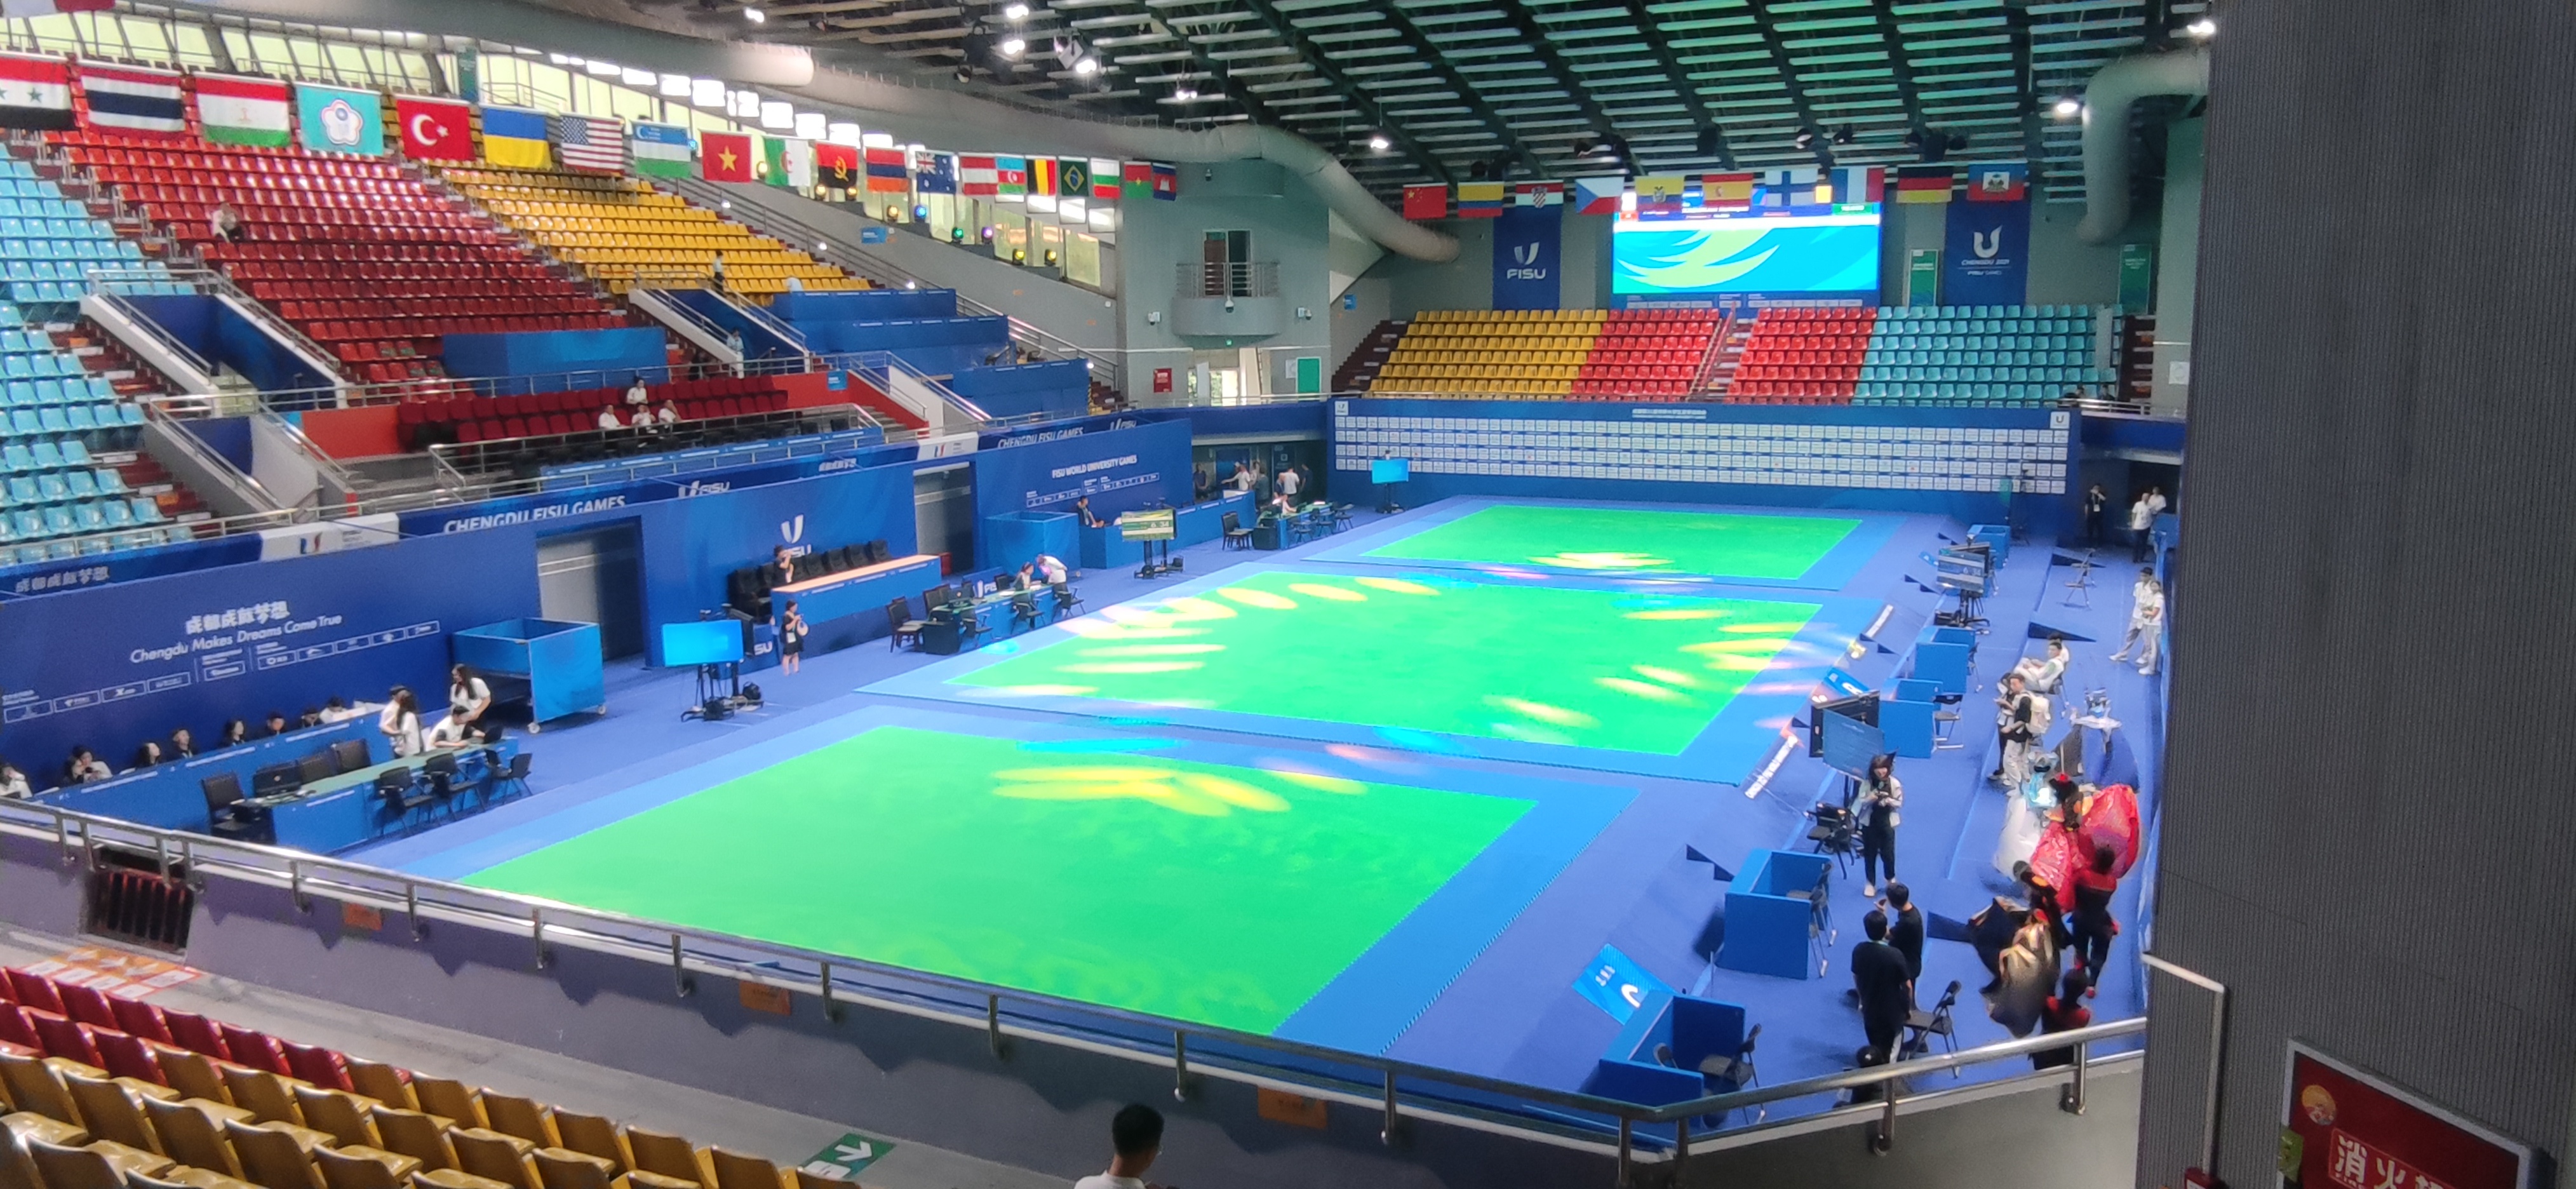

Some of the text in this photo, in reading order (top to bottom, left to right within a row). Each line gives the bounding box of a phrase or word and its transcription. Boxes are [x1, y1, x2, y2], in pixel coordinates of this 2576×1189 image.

[1507, 268, 1546, 279] FISU
[998, 427, 1083, 448] CHENGDU FISU GAMES
[1052, 455, 1137, 478] FISU WORLD UNIVERSITY GAMES
[699, 481, 730, 494] FISU
[444, 495, 626, 534] CHENGDU FISU GAMES
[130, 642, 188, 663] Chengdu
[192, 635, 232, 652] Makes
[237, 625, 282, 643] Dreams
[284, 620, 317, 634] Come
[319, 615, 342, 627] True
[2335, 1134, 2446, 1189] 消火
